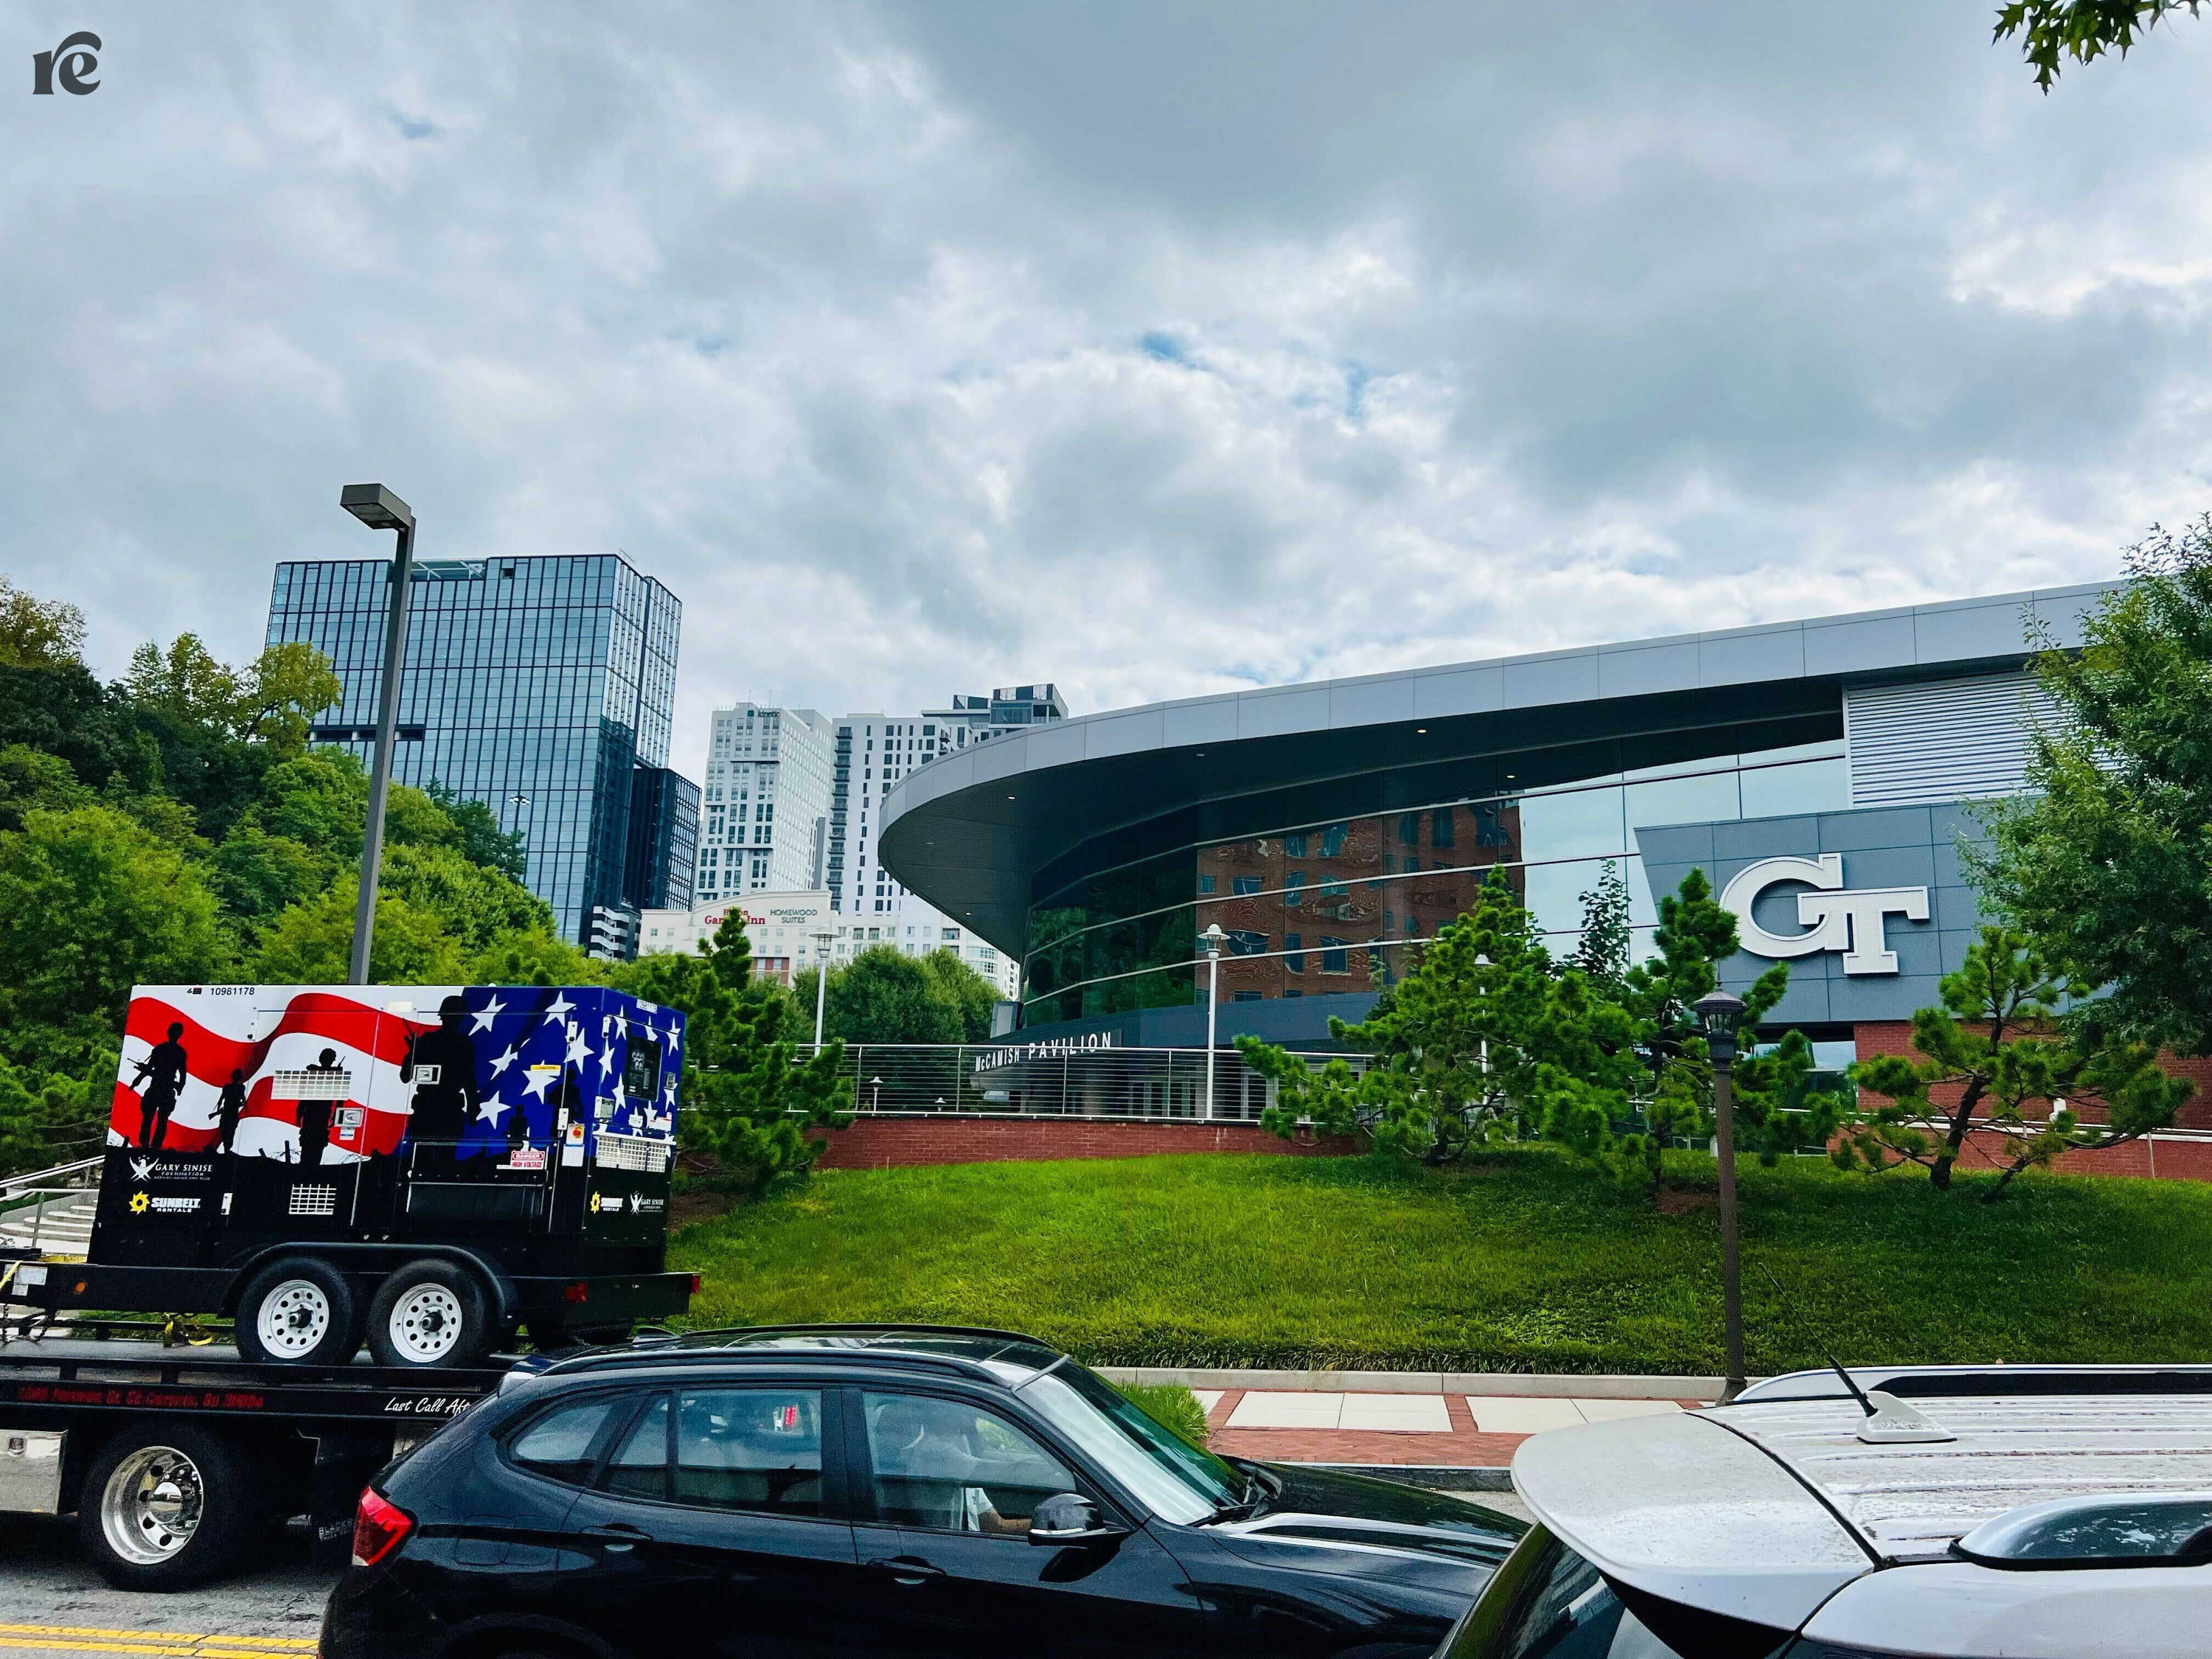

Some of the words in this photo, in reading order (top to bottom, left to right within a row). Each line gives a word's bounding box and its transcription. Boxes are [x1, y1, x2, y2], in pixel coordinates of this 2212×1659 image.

[1719, 852, 1930, 974] GT
[747, 916, 765, 925] Inn
[975, 1048, 1020, 1072] McCAMISH
[1028, 1032, 1112, 1060] PAVILION
[155, 1164, 181, 1172] GARY
[182, 1164, 213, 1172] SINISE
[150, 1197, 201, 1208] SUNBELT
[384, 1397, 413, 1412] Last
[415, 1397, 446, 1413] Call
